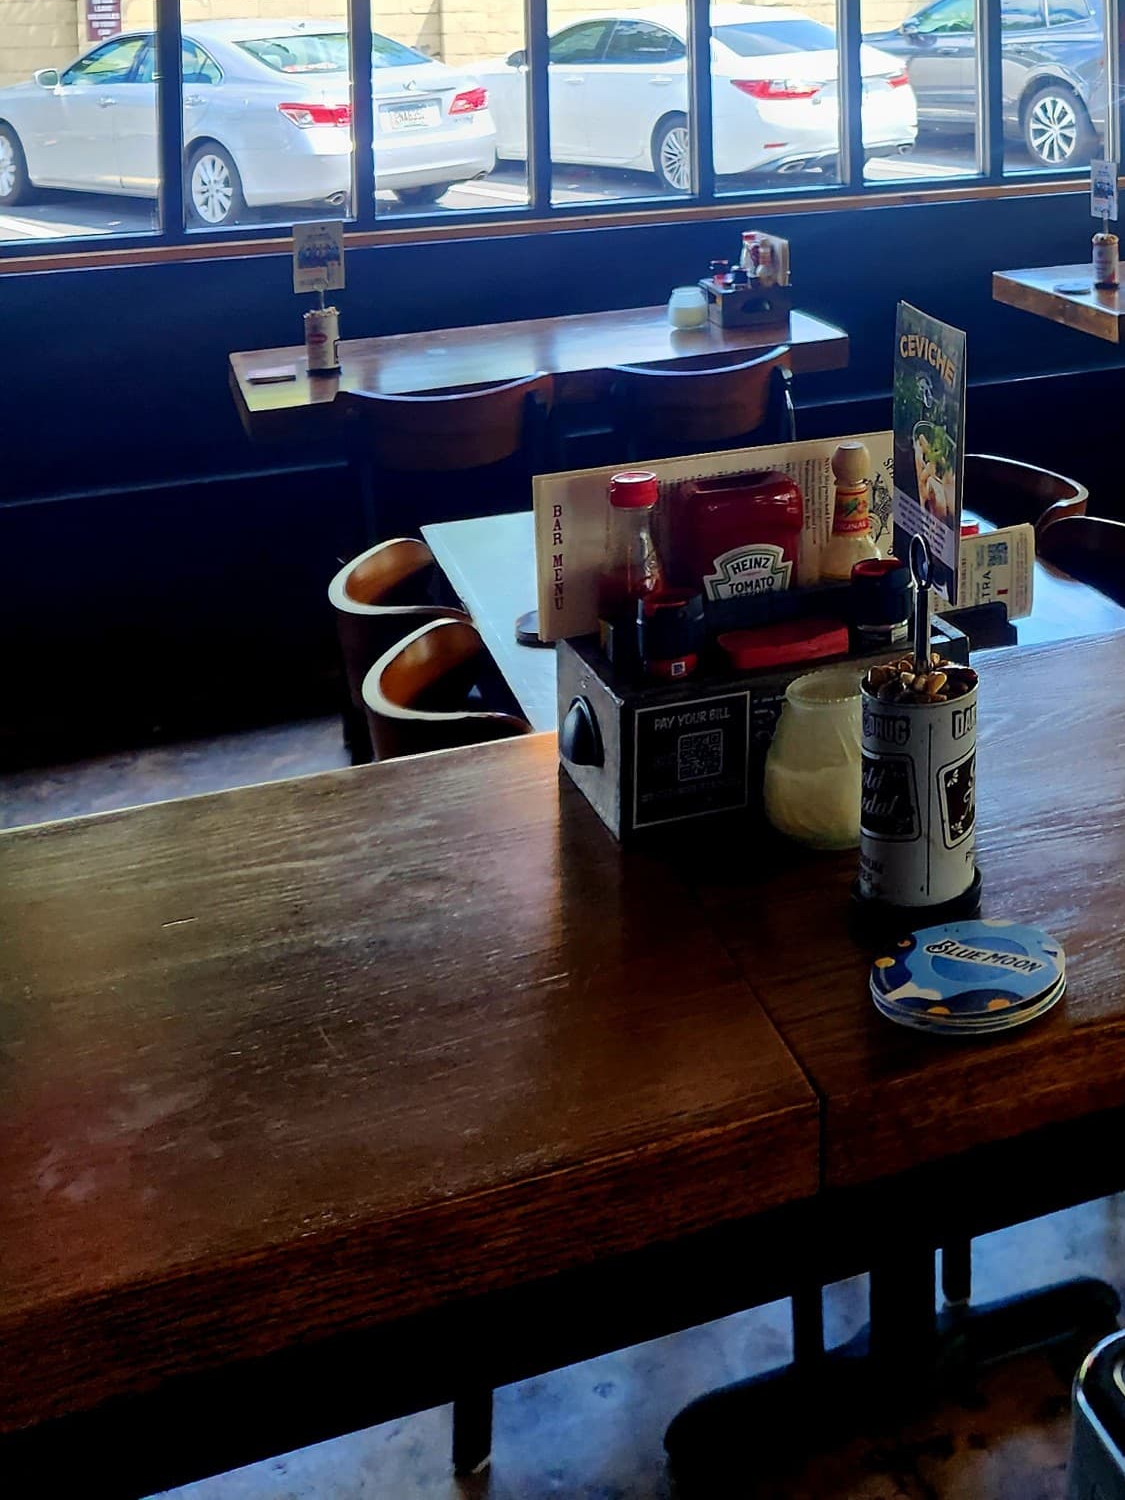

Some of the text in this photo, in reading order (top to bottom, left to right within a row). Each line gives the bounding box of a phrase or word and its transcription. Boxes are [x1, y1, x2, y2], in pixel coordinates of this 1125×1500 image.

[900, 333, 956, 389] CEVICHE
[553, 504, 564, 610] BAR MENU
[730, 556, 770, 575] HEINZ
[728, 575, 775, 594] TOMATO
[654, 706, 731, 731] PAY YOUR BILL
[926, 939, 1043, 973] BLUE MOON
